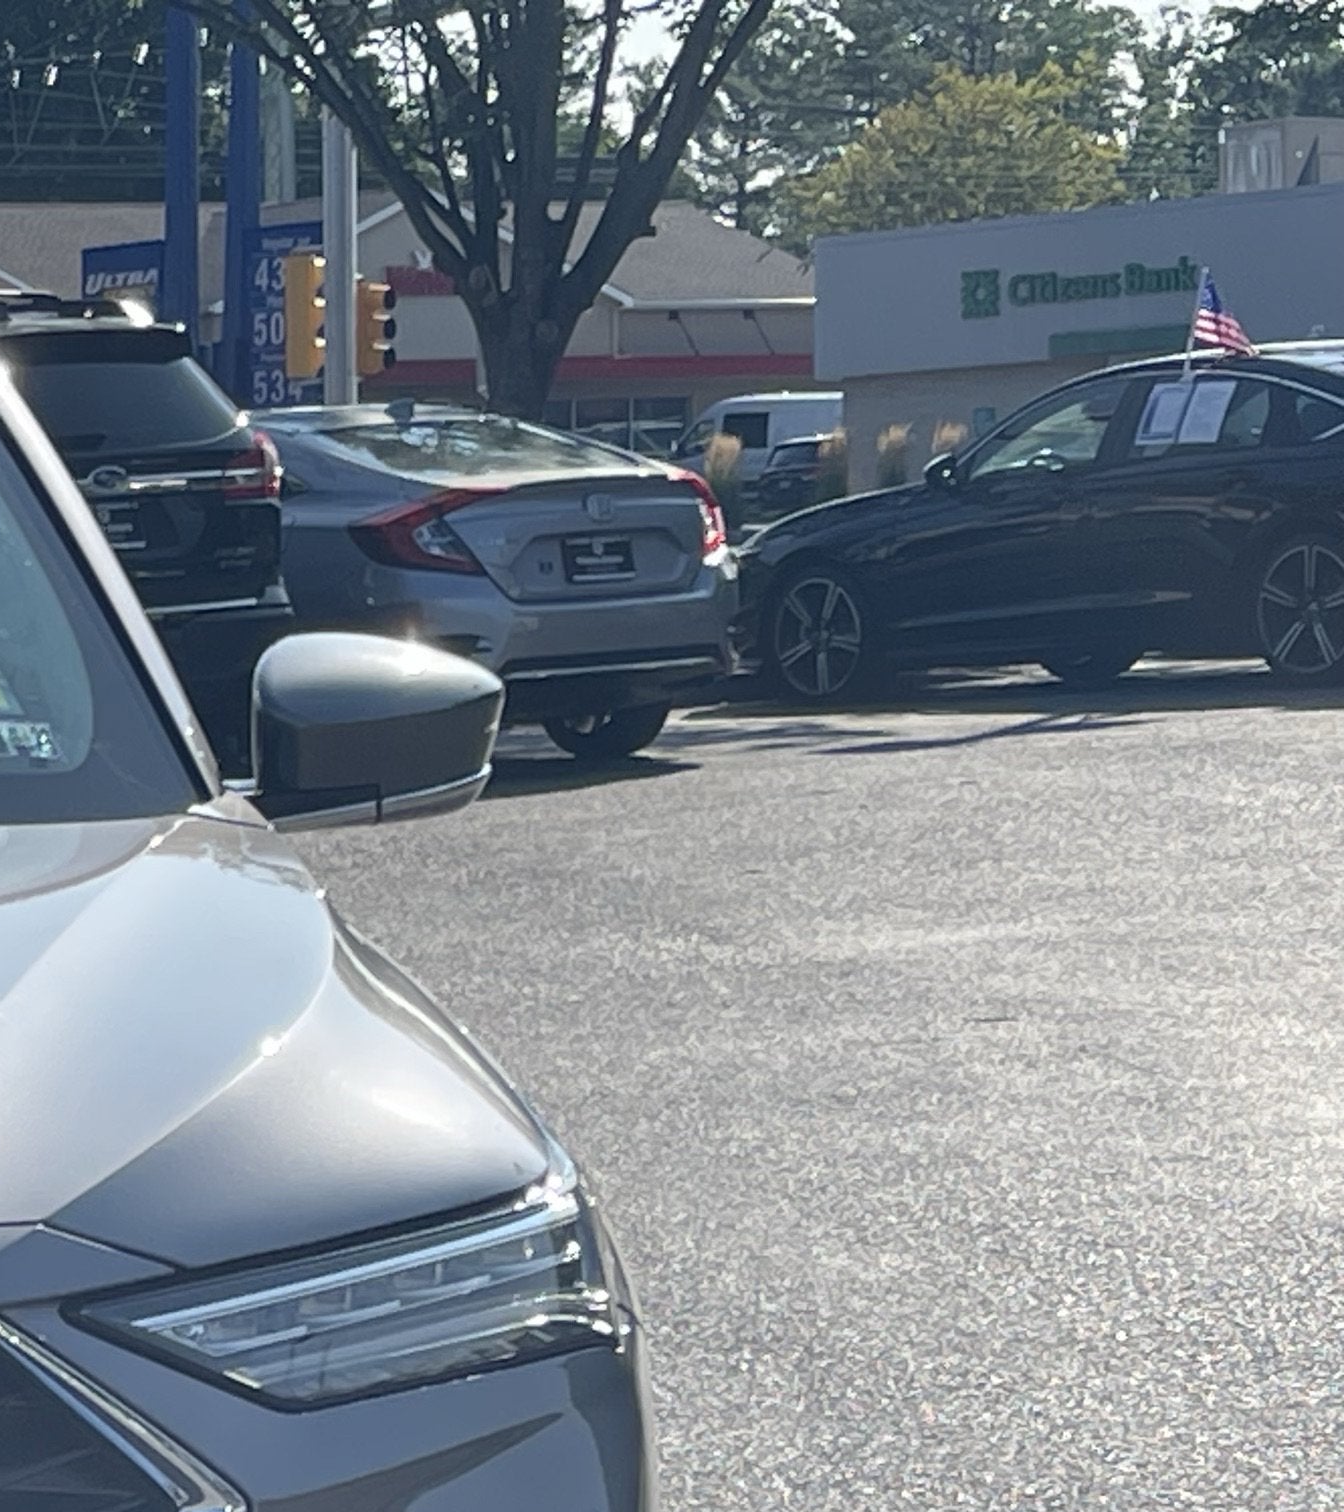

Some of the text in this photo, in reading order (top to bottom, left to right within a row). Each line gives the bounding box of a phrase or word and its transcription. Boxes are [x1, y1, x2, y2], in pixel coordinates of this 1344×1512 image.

[84, 267, 159, 296] ULTRA
[254, 257, 286, 292] 43
[1124, 255, 1198, 297] Bank
[253, 311, 286, 346] 50
